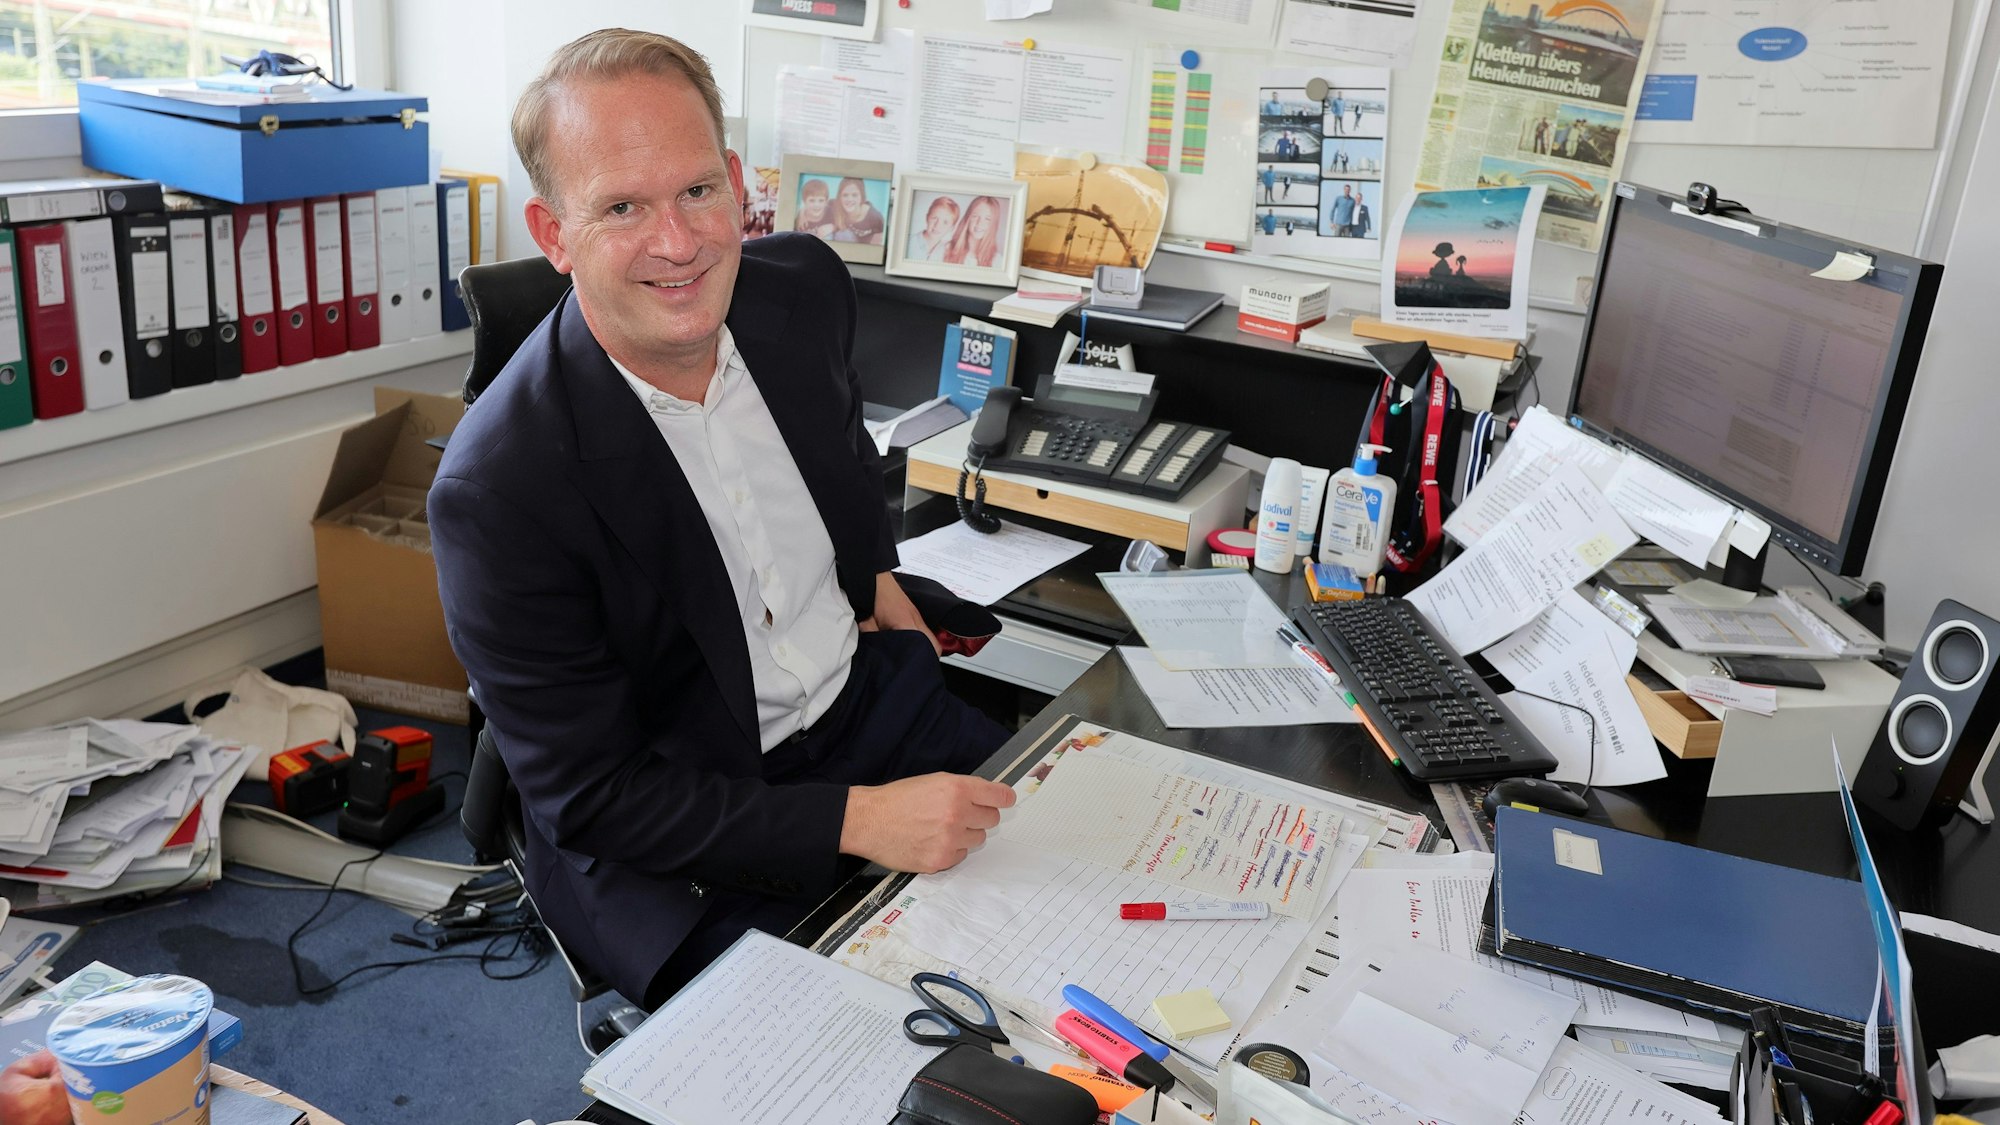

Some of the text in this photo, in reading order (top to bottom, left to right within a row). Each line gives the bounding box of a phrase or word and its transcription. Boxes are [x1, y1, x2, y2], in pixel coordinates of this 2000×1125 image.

[1476, 42, 1537, 68] Klettern
[1538, 52, 1582, 75] übers
[1472, 60, 1601, 98] Henkelmännchen
[1249, 288, 1292, 302] mundart
[961, 351, 991, 366] 500
[962, 337, 993, 355] TOP
[1432, 375, 1445, 407] REWE
[1424, 434, 1438, 466] REWE
[1336, 485, 1378, 505] CeraVe
[1563, 670, 1581, 697] mich
[1578, 659, 1597, 692] Jeder
[1593, 690, 1612, 726] Bissen
[1072, 1015, 1118, 1045] STABILO BOSS
[1096, 1075, 1125, 1088] STABILO
